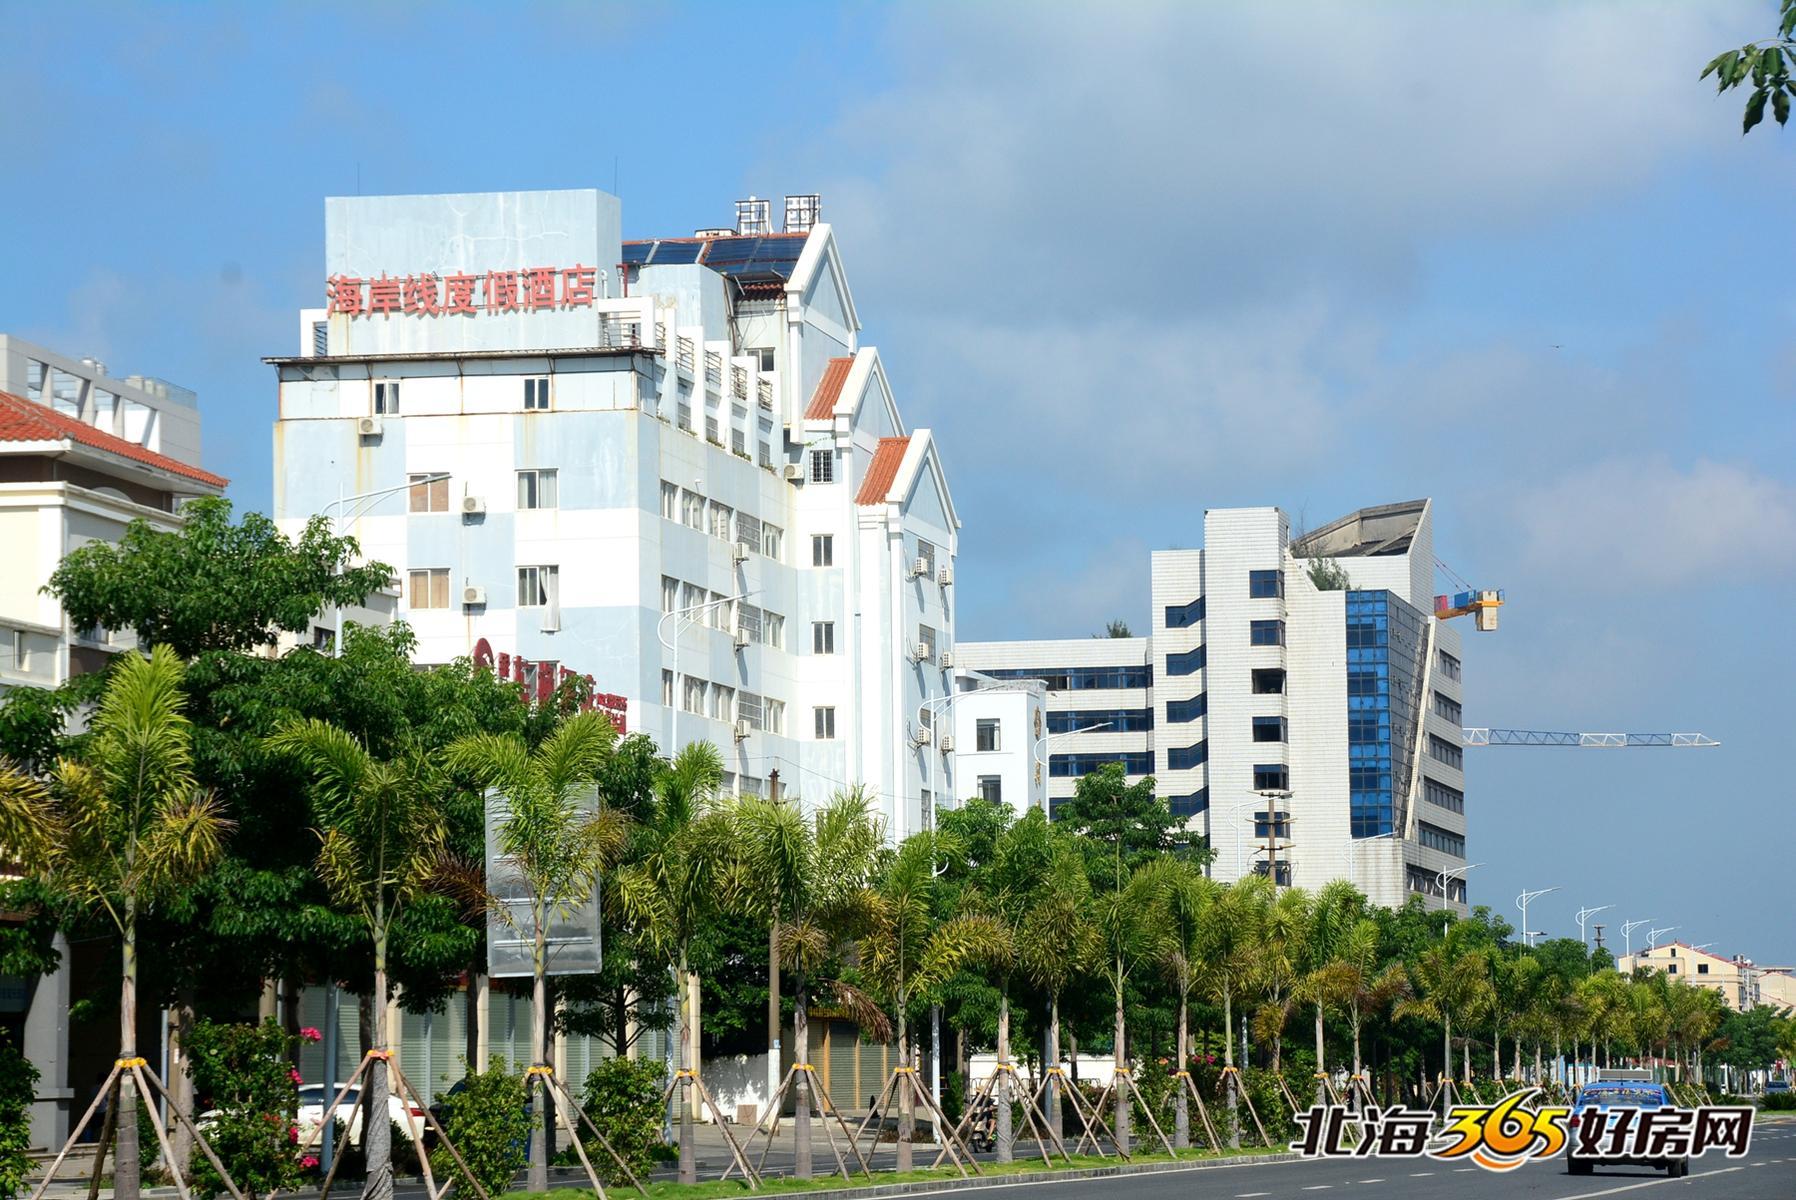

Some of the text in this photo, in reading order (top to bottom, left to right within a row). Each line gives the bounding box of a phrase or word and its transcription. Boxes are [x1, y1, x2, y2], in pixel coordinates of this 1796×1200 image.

[327, 263, 597, 318] 海岸线度假酒店
